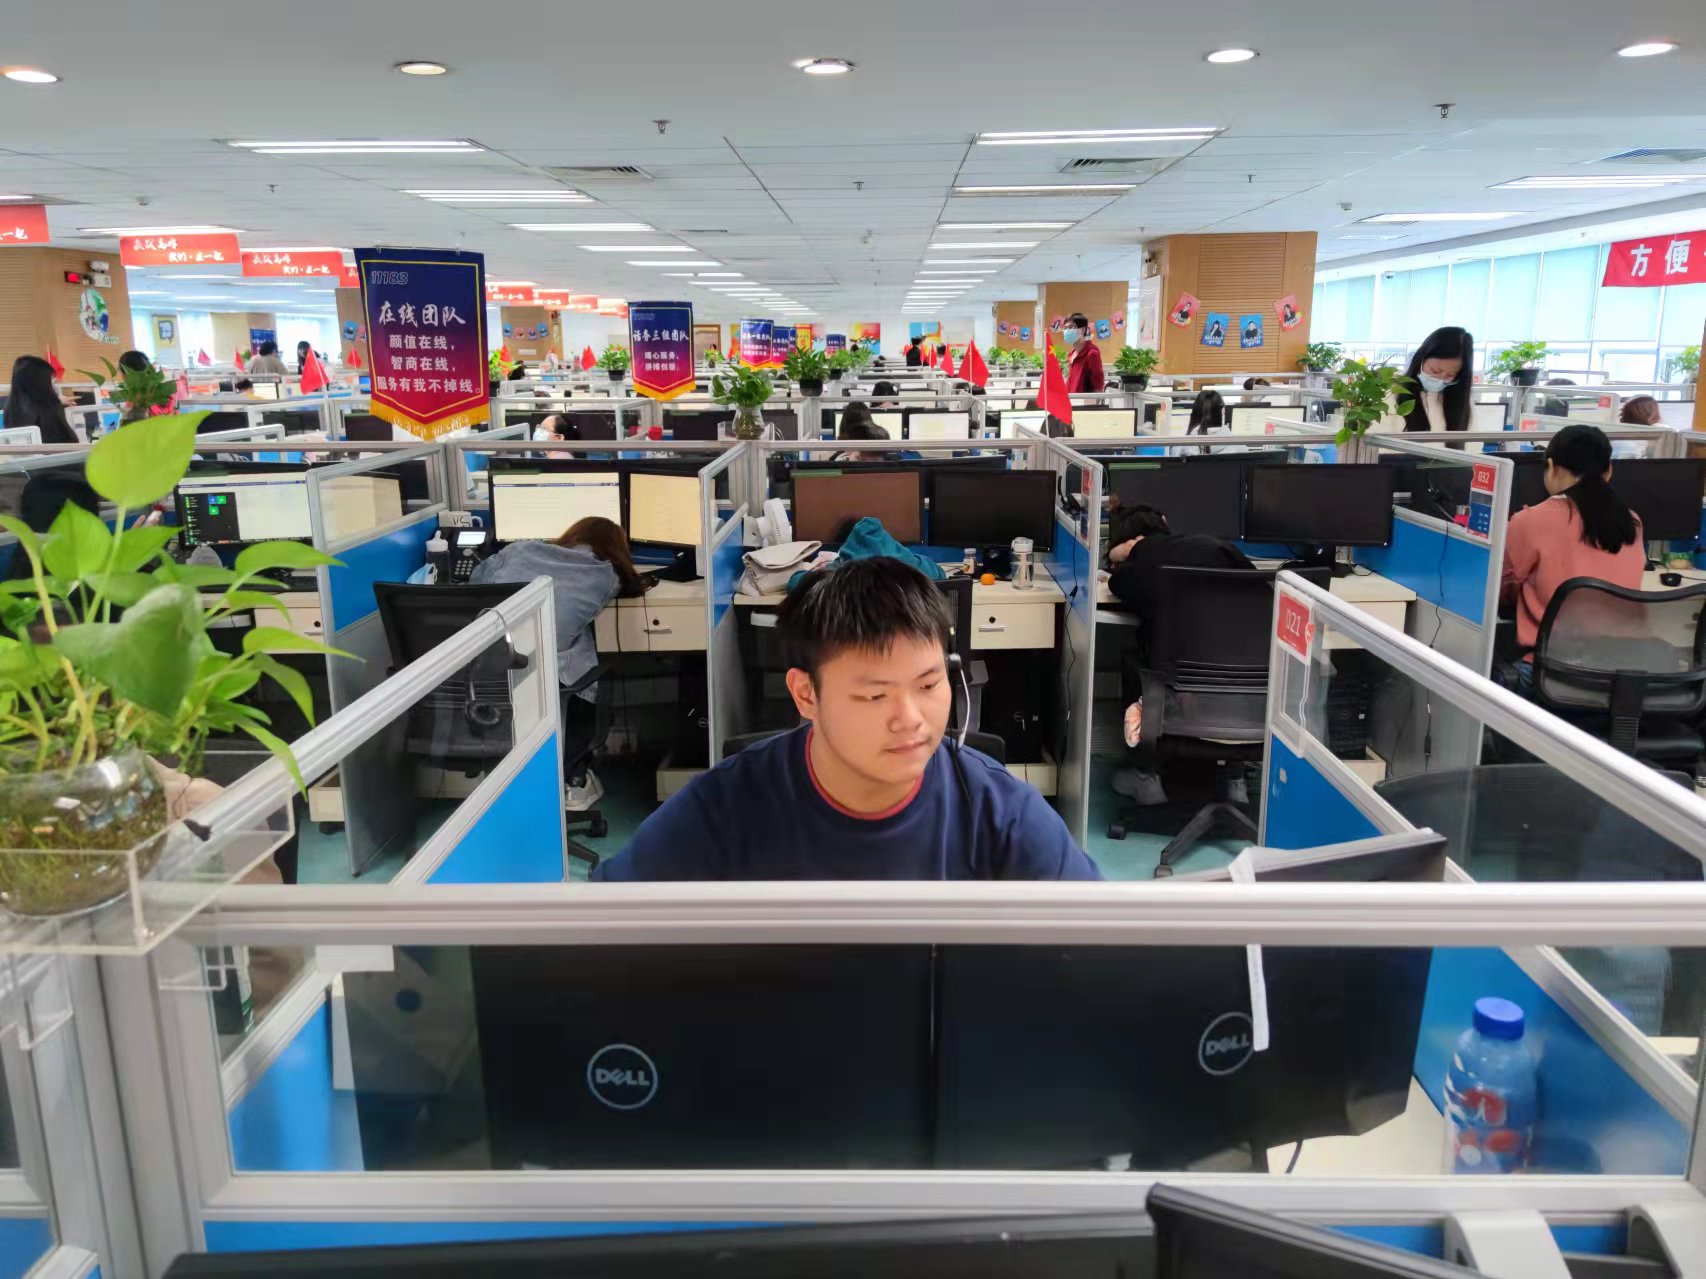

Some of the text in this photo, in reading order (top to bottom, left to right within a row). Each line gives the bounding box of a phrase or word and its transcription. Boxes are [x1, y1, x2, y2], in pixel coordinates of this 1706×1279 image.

[371, 271, 408, 284] 11183
[379, 301, 466, 327] 在线团队
[1286, 608, 1301, 637] 021
[1205, 1032, 1250, 1057] DELL
[595, 1067, 651, 1087] DELL
